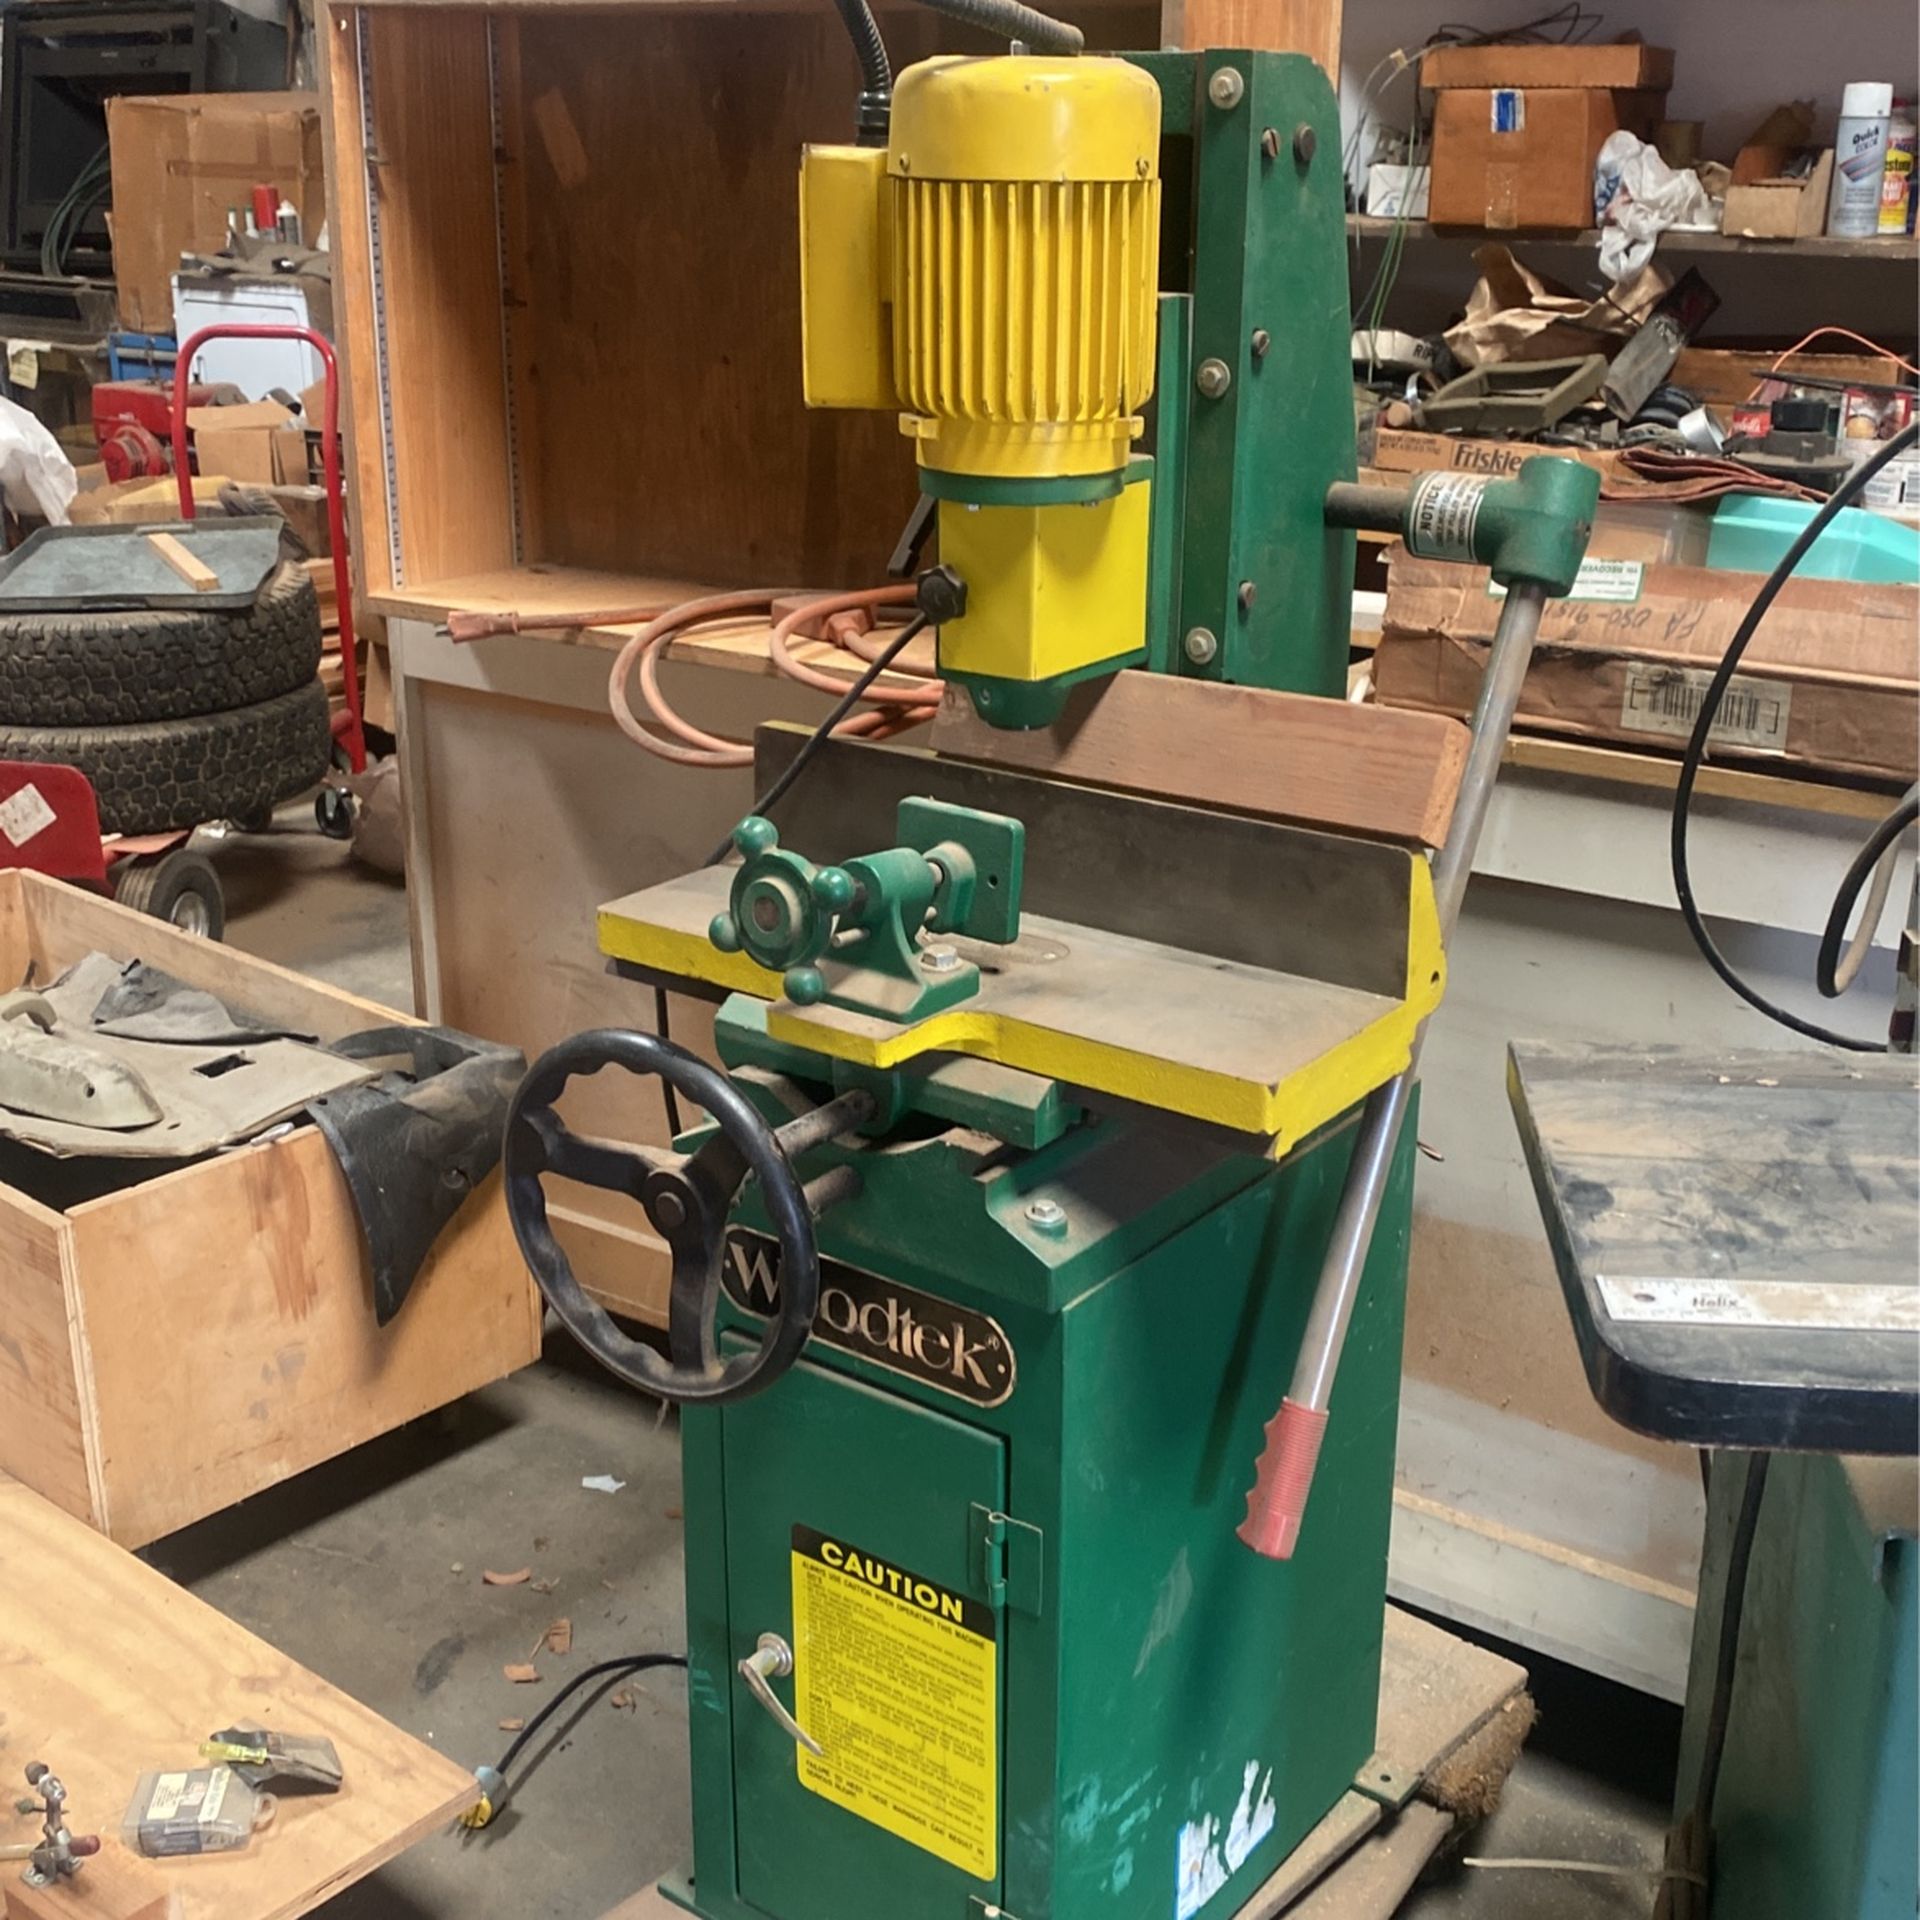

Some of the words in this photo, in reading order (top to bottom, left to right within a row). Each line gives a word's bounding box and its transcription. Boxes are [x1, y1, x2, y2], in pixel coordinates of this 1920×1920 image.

[1853, 125, 1879, 144] Quick
[1454, 443, 1523, 472] Friskie
[1420, 483, 1444, 531] NOTICE
[729, 1242, 991, 1389] Wodtek
[1693, 1296, 1738, 1308] Helix
[821, 1542, 962, 1623] CAUTION
[844, 1579, 871, 1597] CAUTION
[896, 1603, 933, 1626] OPERATING
